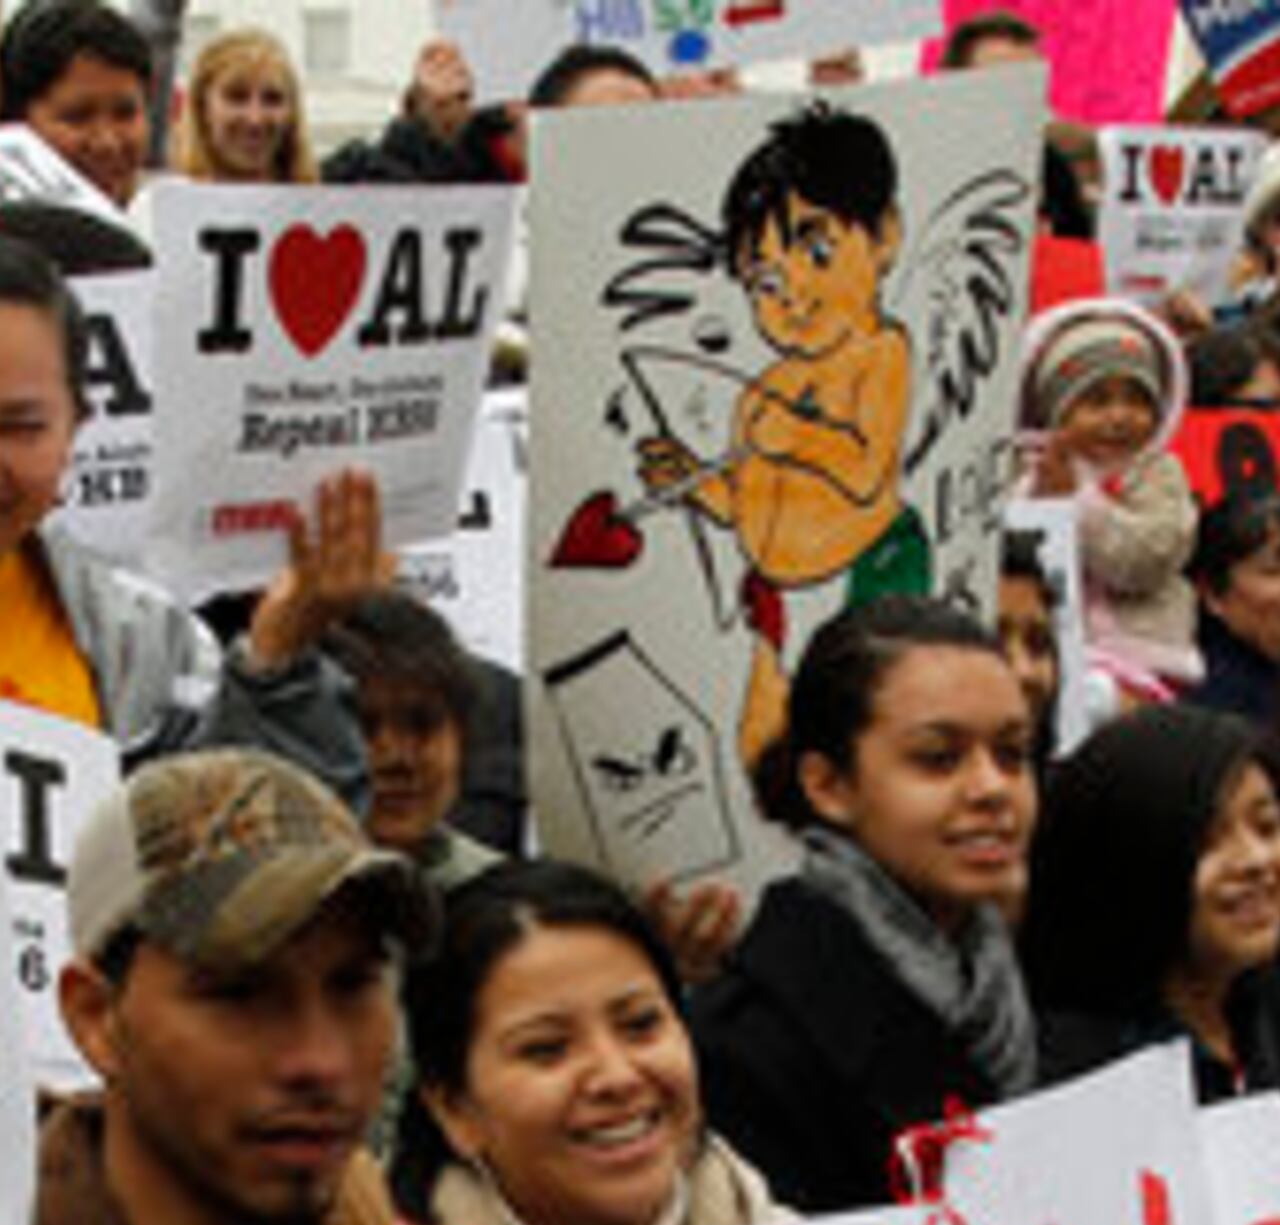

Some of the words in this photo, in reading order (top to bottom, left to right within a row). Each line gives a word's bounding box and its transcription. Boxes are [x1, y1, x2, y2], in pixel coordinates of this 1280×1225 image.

[197, 229, 261, 353] I
[358, 228, 488, 347] AL
[75, 312, 153, 415] A
